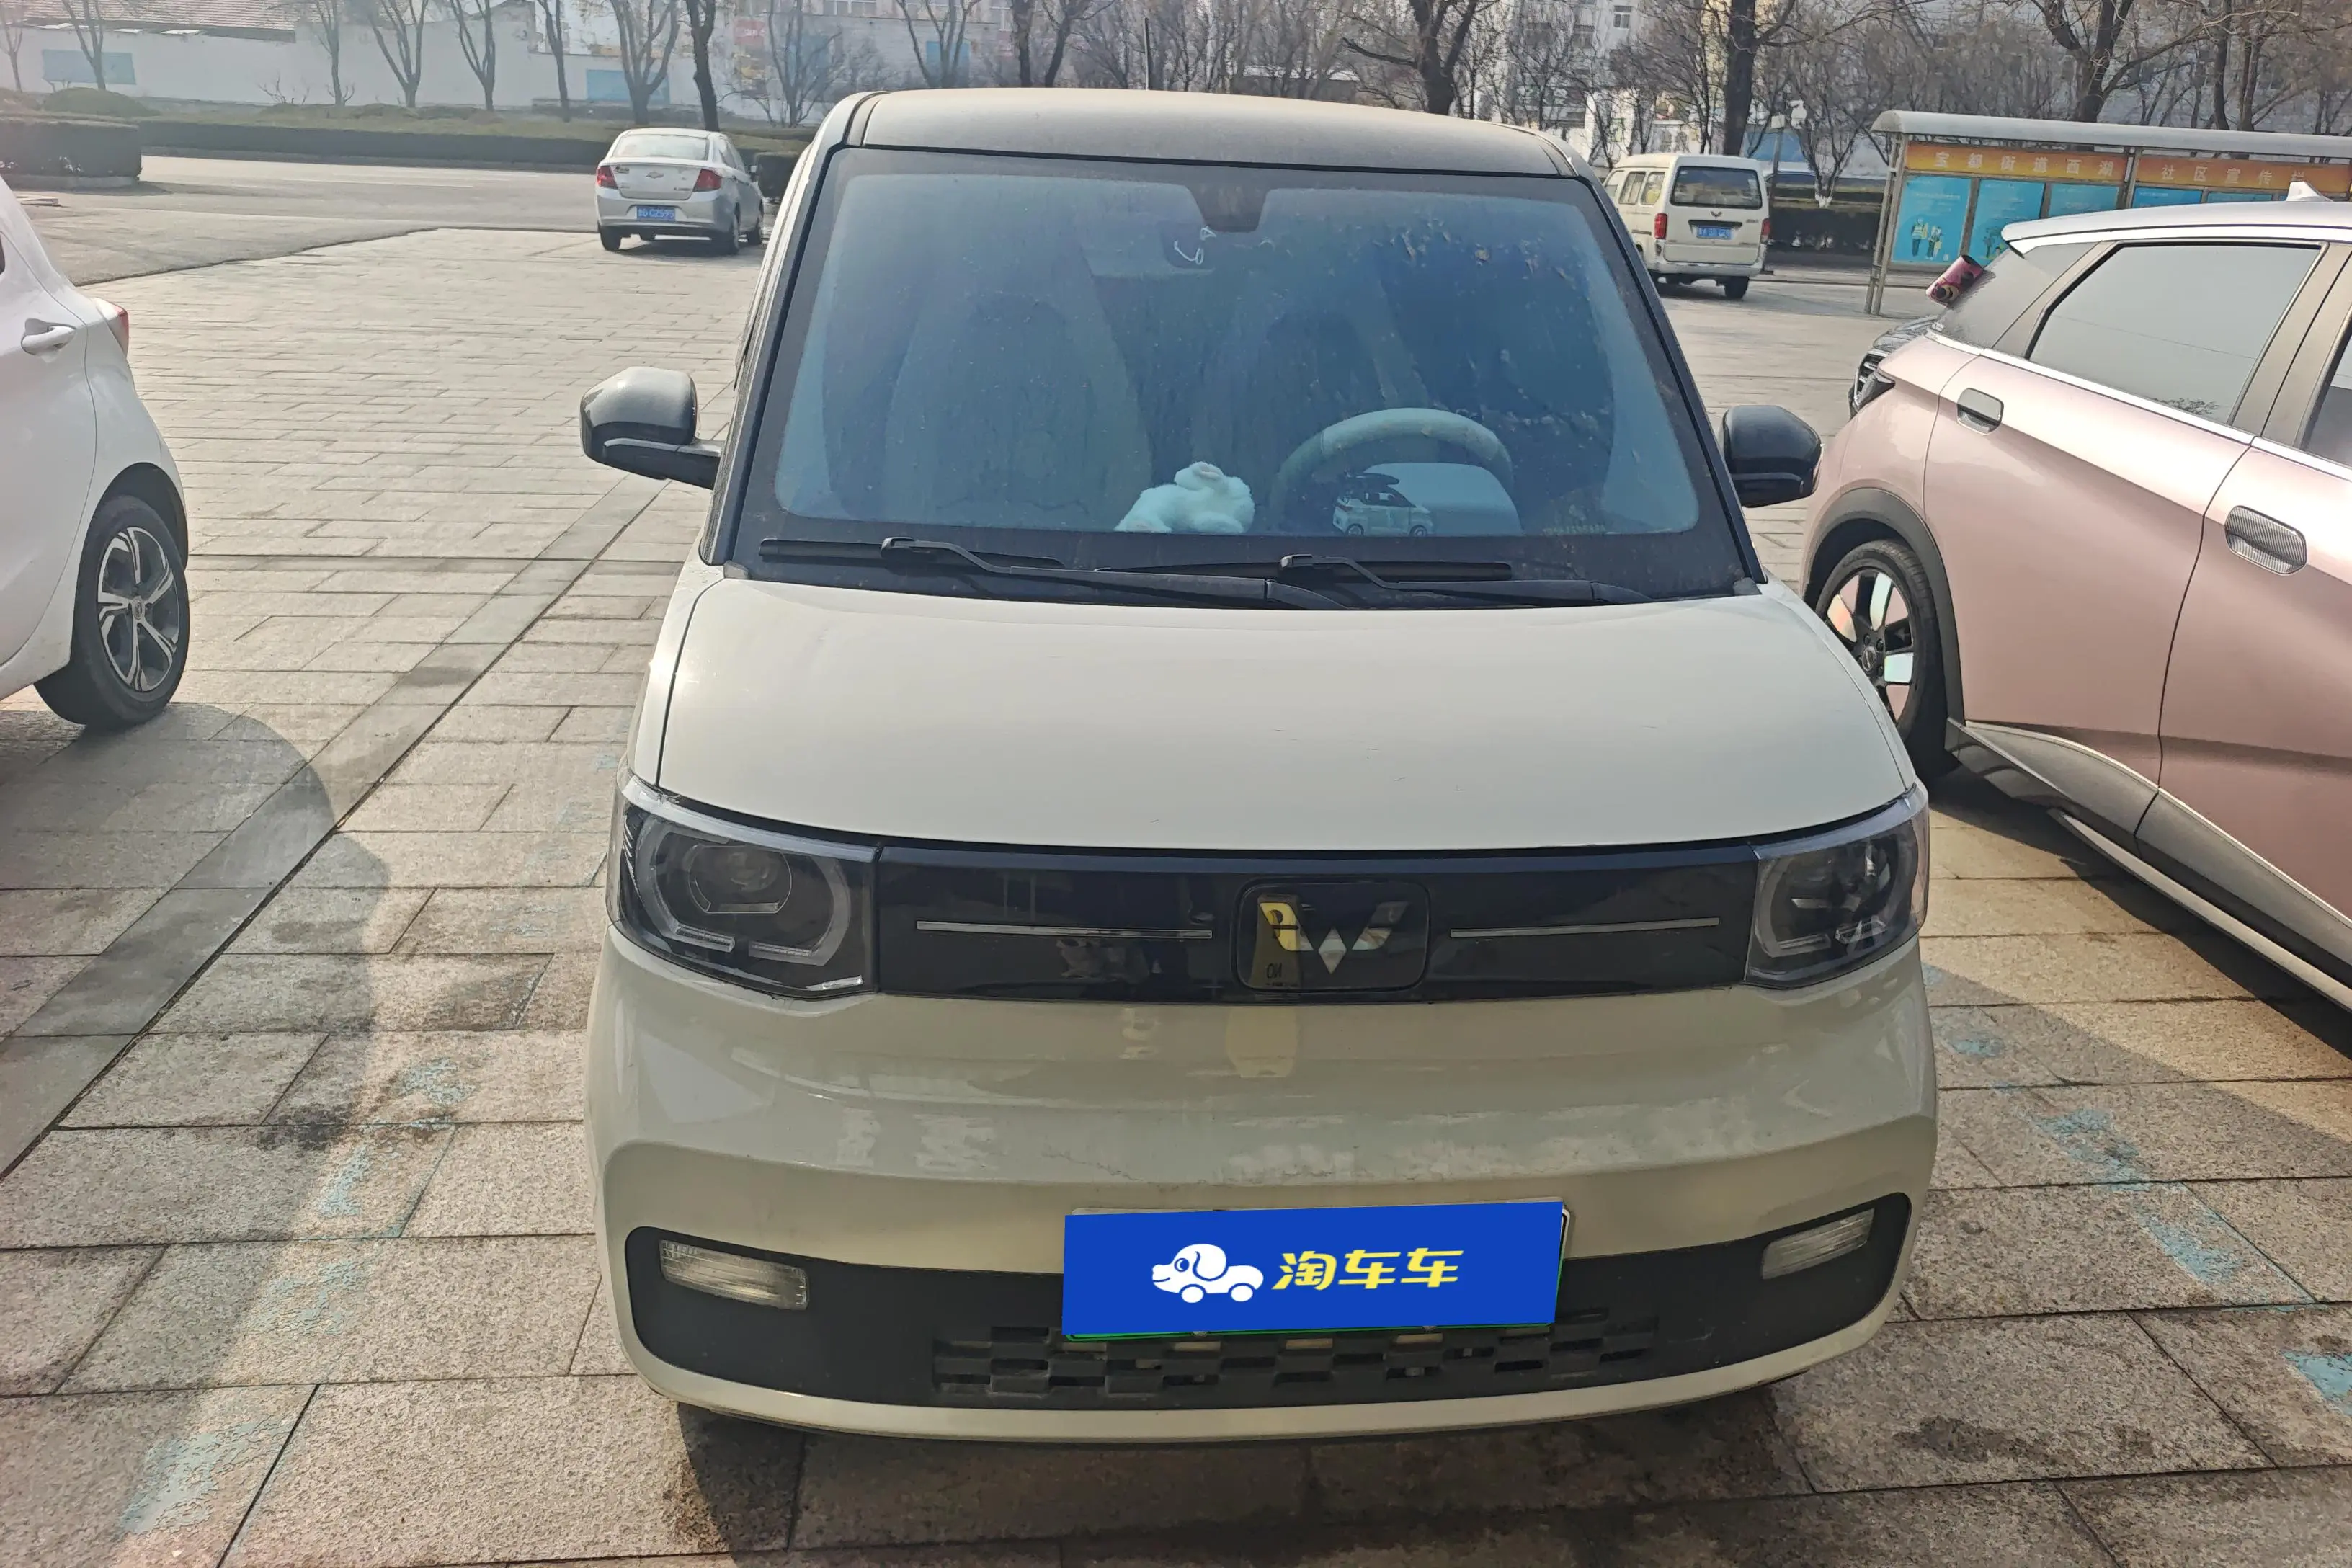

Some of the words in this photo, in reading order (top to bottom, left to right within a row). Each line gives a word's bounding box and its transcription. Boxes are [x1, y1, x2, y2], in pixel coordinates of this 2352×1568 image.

[1934, 151, 2115, 177] 宝都街道西湖
